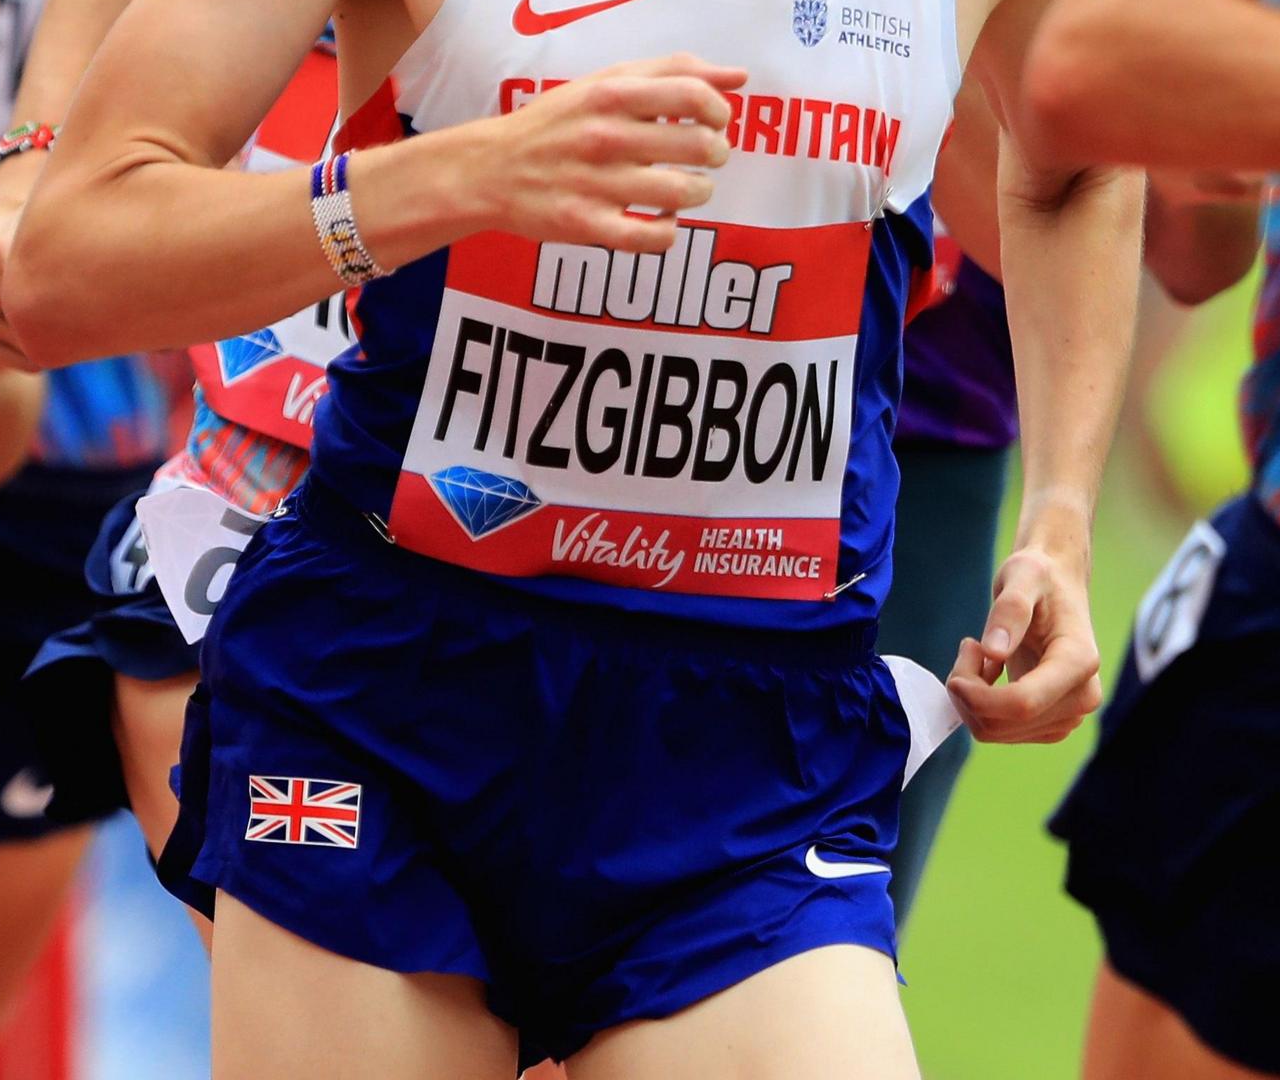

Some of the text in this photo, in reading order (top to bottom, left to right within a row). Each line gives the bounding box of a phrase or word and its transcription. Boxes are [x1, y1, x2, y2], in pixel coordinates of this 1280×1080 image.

[841, 6, 911, 39] BRITISH
[838, 31, 911, 58] ATHLETICS
[433, 316, 839, 485] FITZGIBBON
[550, 512, 687, 589] Vitality
[699, 527, 784, 552] HEALTH
[693, 552, 821, 580] INSURANCE
